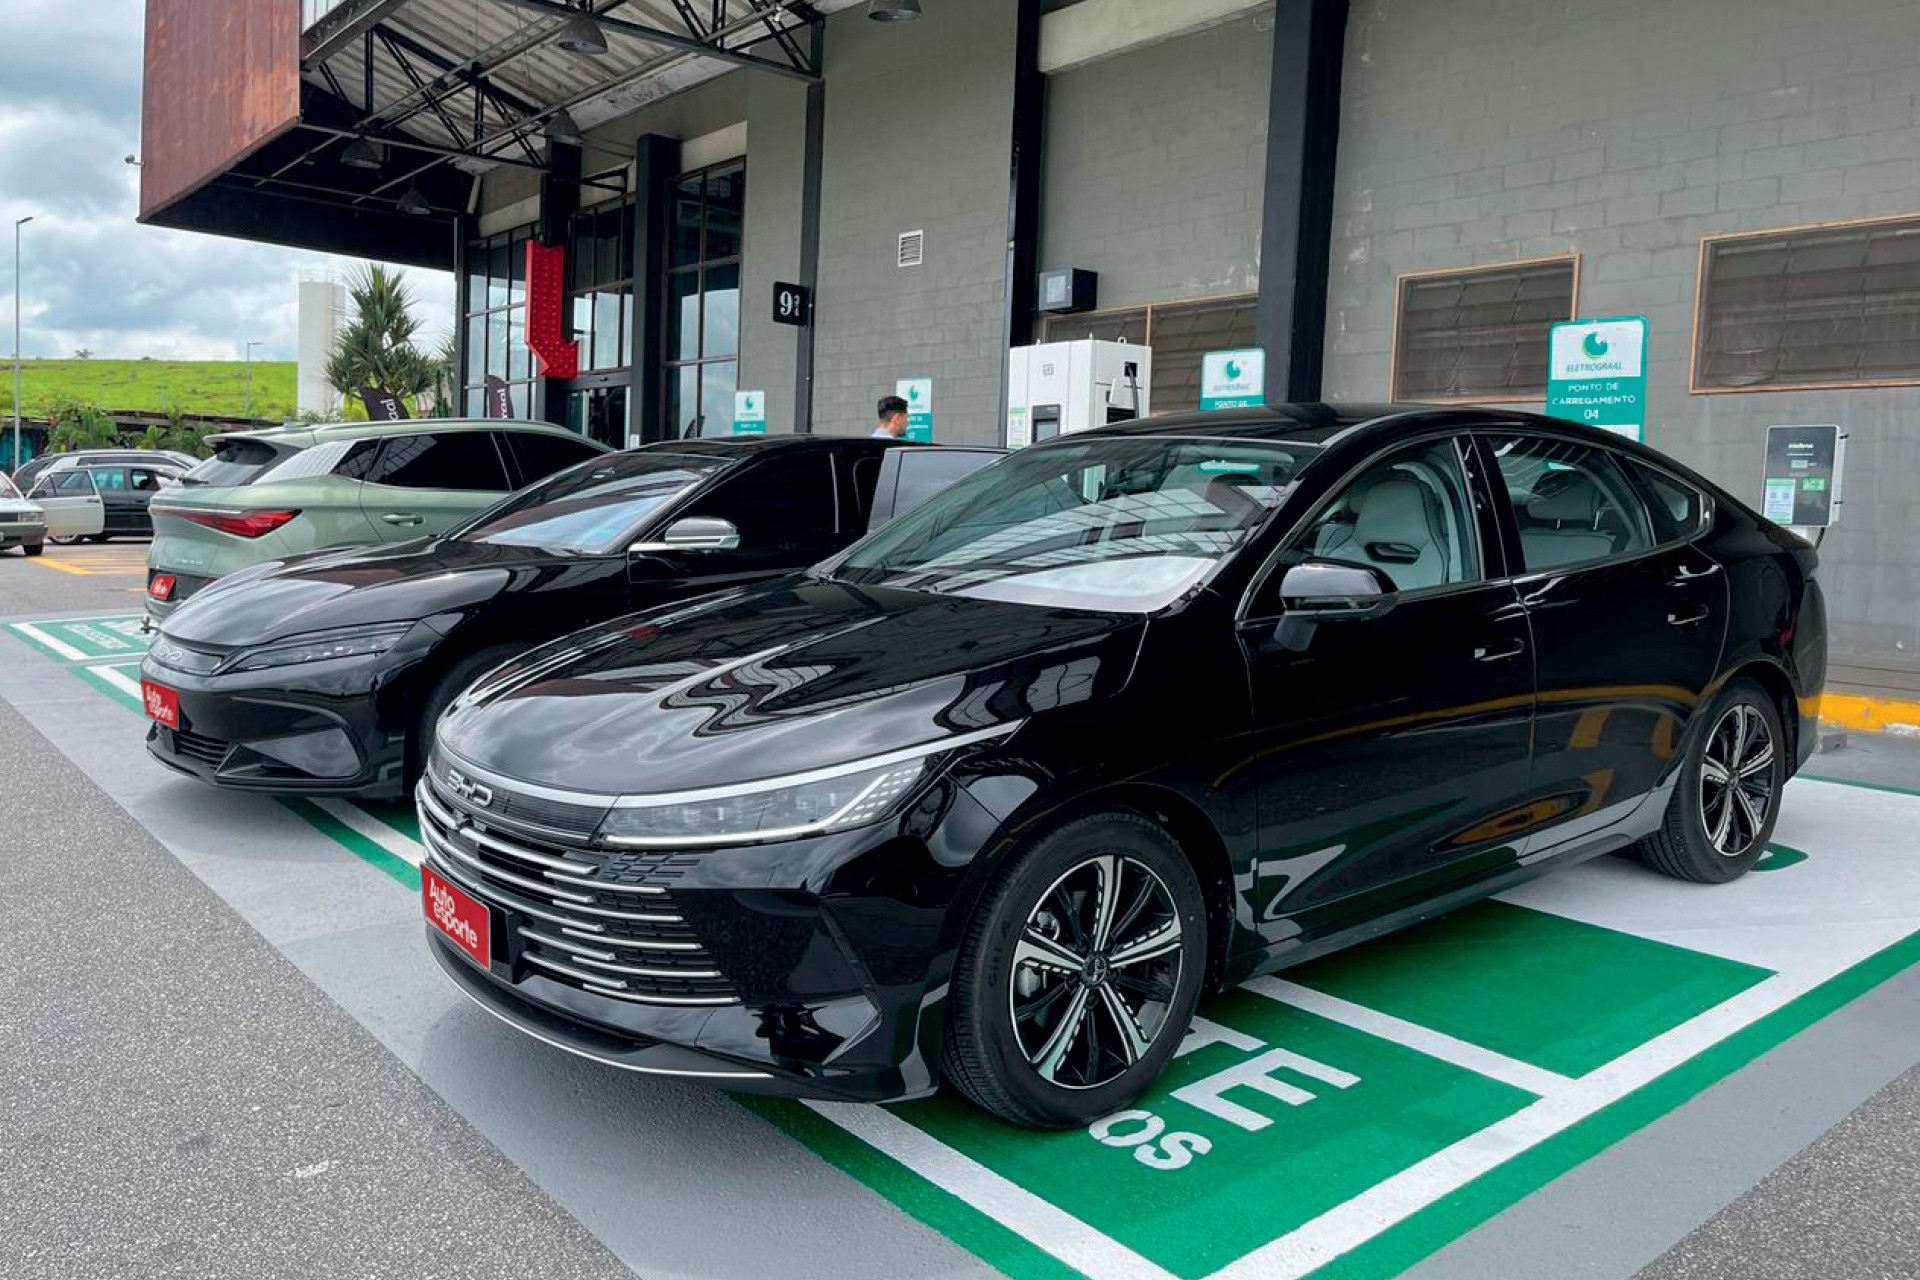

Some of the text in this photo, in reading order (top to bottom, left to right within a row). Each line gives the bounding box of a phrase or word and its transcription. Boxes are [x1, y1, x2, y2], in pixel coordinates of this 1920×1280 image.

[1568, 382, 1619, 392] PONTO DE
[1552, 395, 1636, 405] CARREGAMENTO
[1583, 409, 1599, 420] 04
[448, 769, 493, 807] BYD
[429, 877, 455, 915] Auto
[433, 899, 478, 949] esporte
